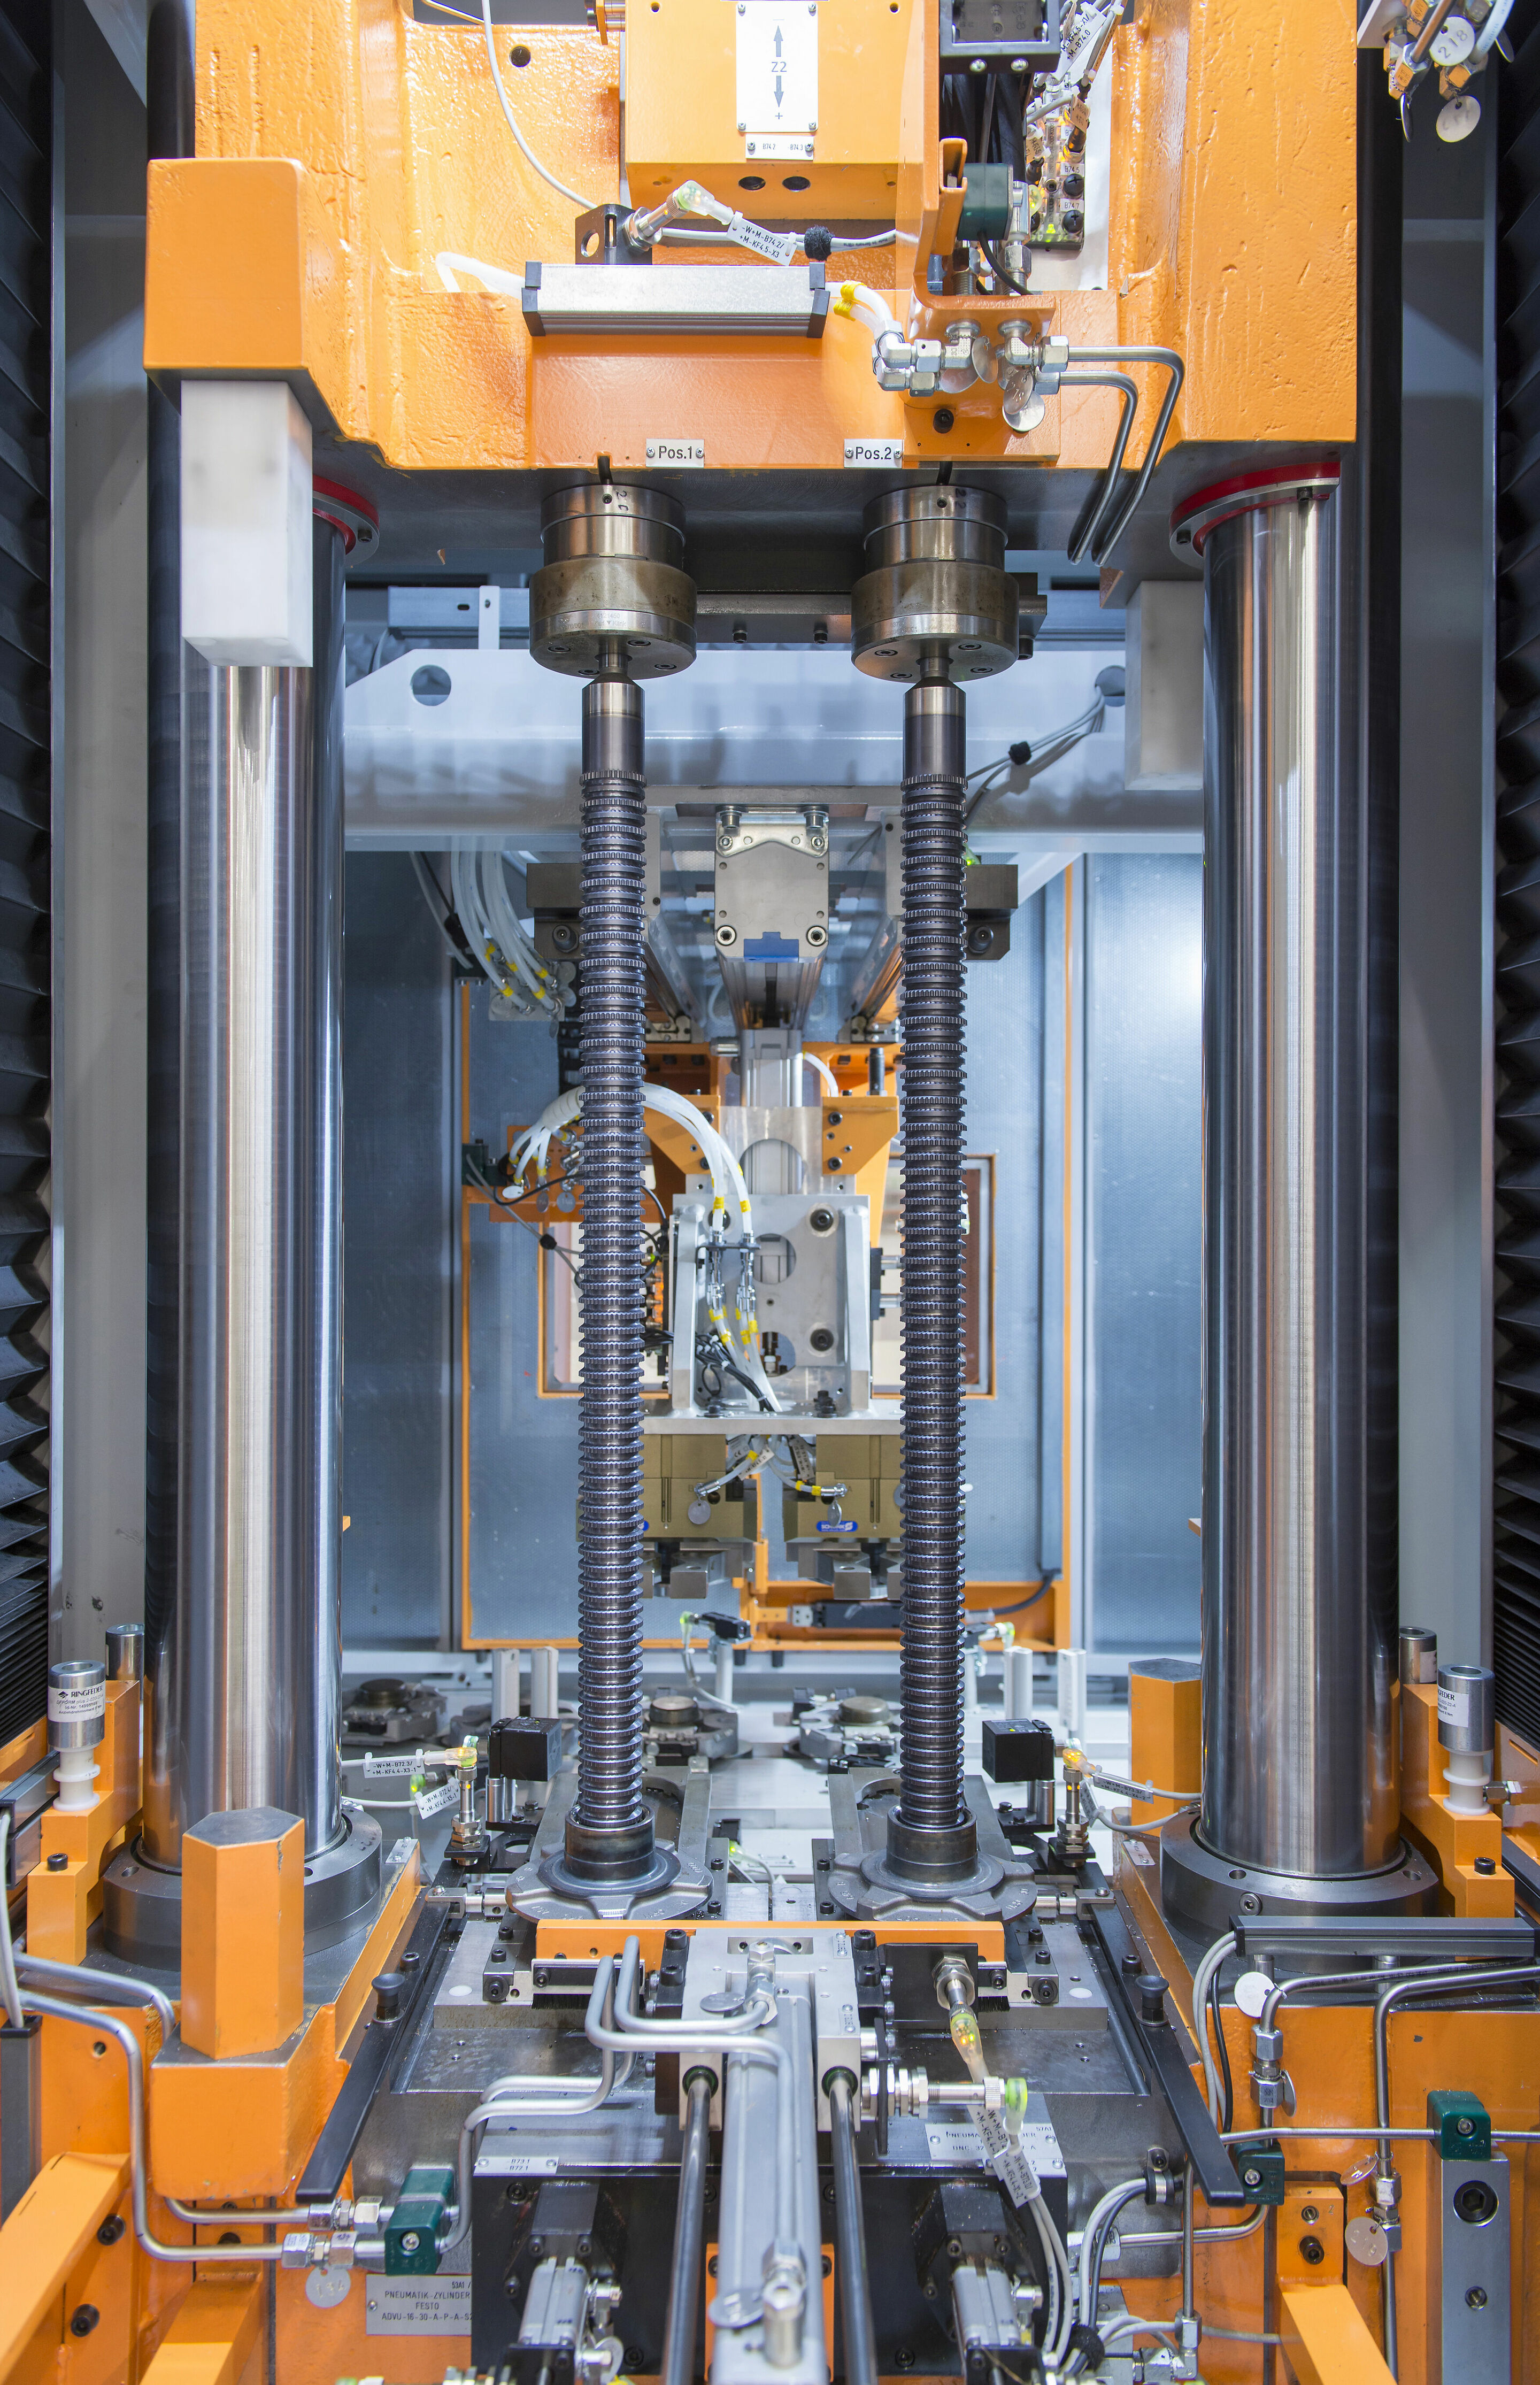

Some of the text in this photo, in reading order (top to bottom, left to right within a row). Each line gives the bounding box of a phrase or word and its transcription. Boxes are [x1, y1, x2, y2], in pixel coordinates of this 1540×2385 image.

[1067, 29, 1091, 60] +M-B74.0
[1438, 30, 1468, 58] 218
[771, 61, 787, 72] Z2
[1065, 165, 1080, 173] B74.5
[742, 225, 784, 249] -W+M-B74.2/
[740, 235, 780, 258] +M-KF4.5-X3
[659, 445, 692, 459] Pos.1
[856, 446, 892, 460] Pos.2
[71, 1685, 103, 1698] RINGFEDER
[384, 2290, 471, 2299] PNEUMATIK-ZYLINDER
[415, 2302, 440, 2310] FESTO
